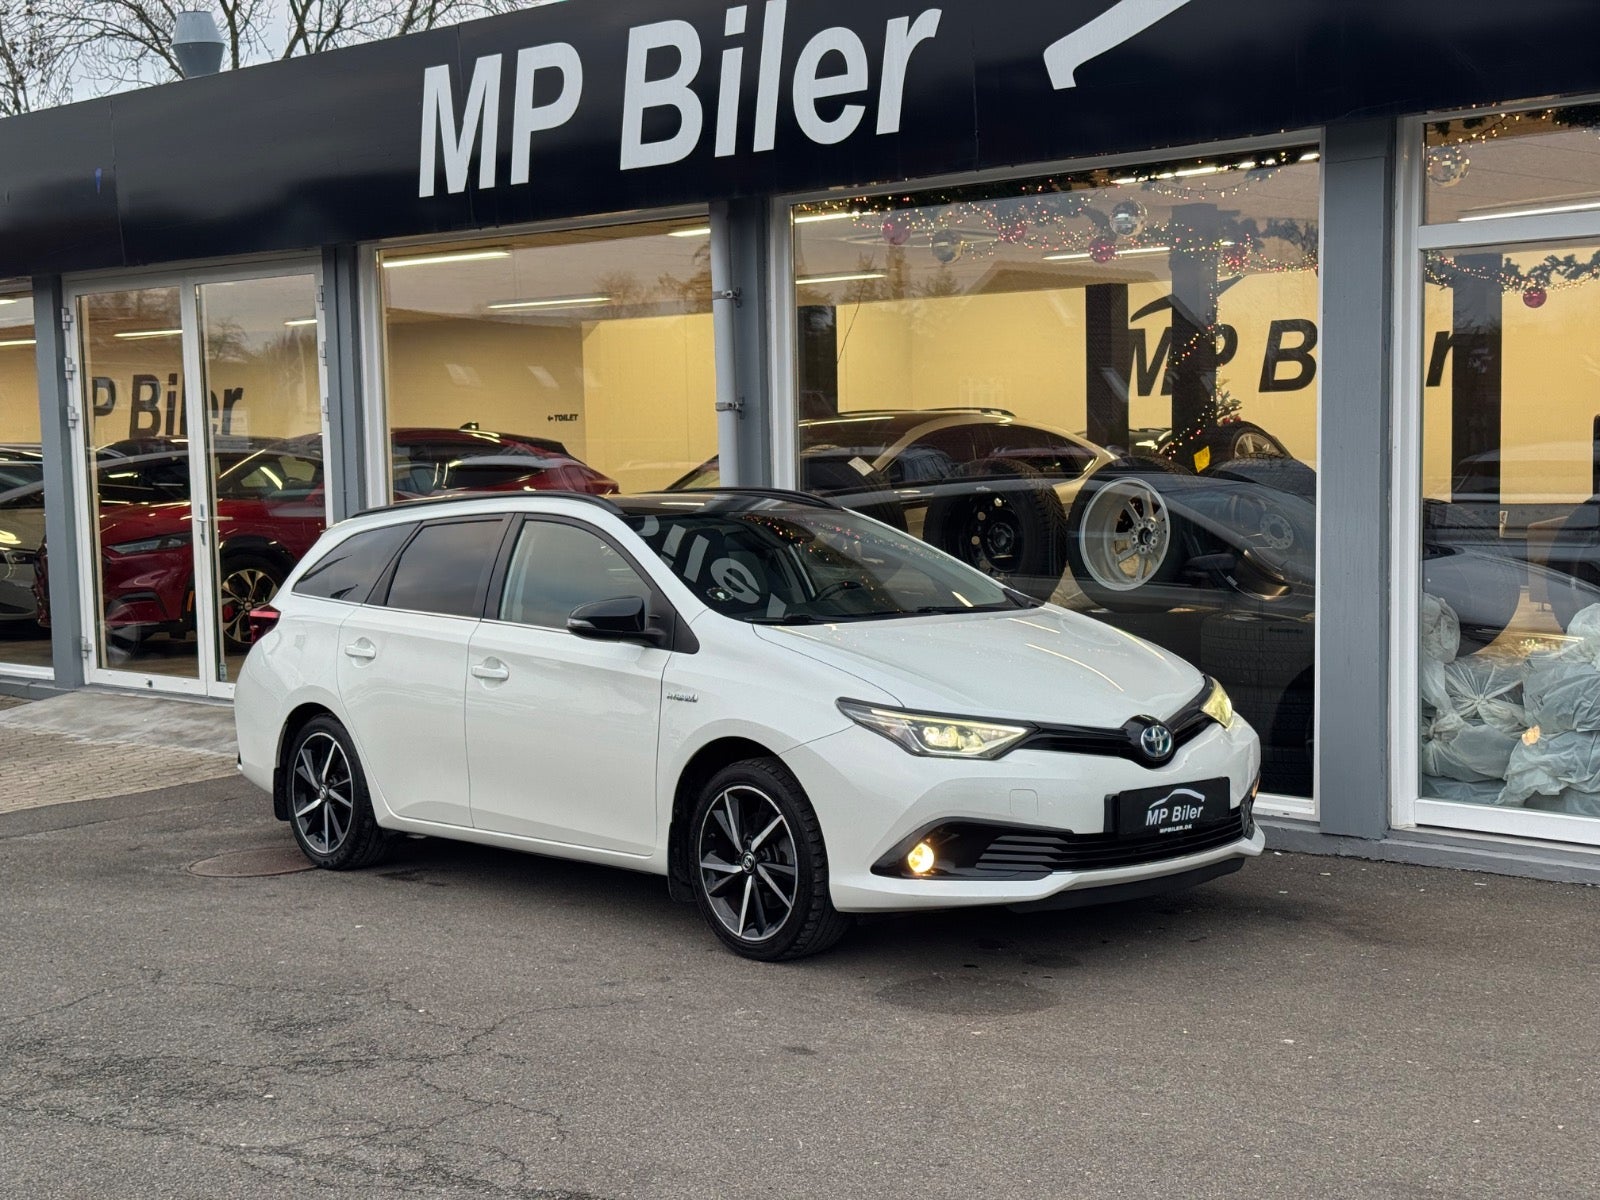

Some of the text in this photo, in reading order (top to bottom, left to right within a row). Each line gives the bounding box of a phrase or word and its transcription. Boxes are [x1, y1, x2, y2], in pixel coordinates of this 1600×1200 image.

[419, 0, 942, 197] MP Biler
[554, 414, 578, 422] TOILET
[1146, 805, 1203, 826] MP Biler
